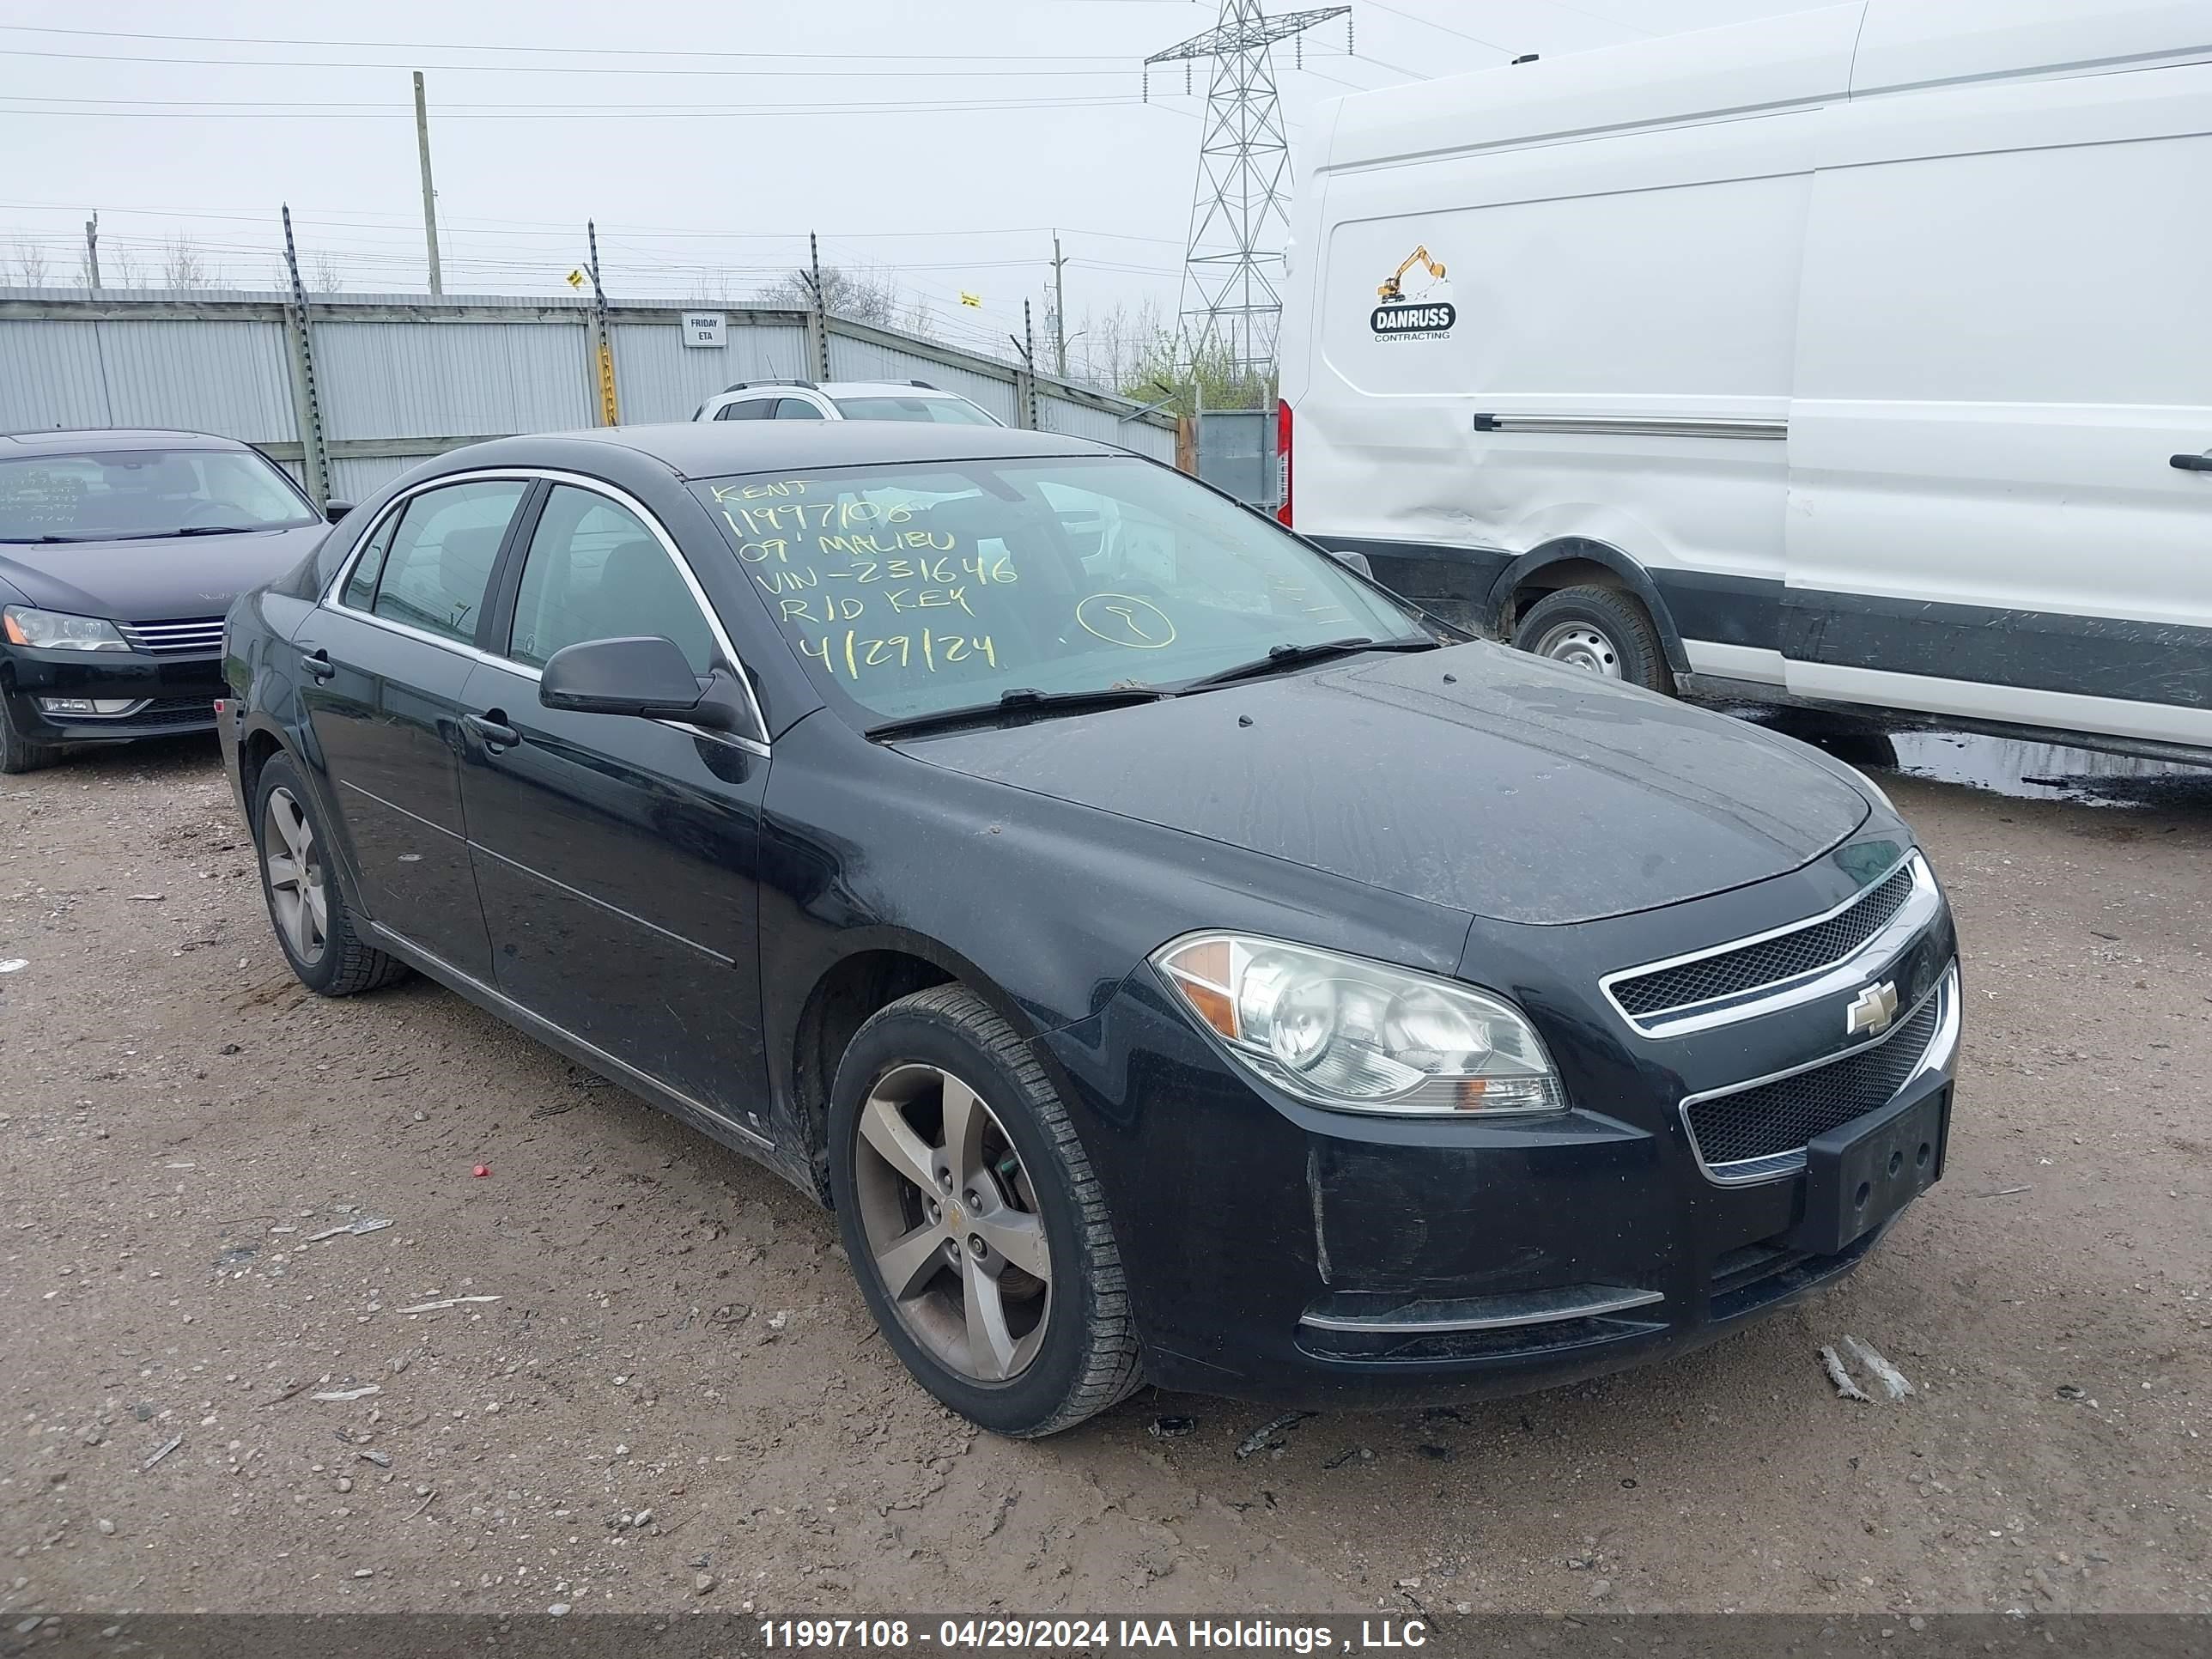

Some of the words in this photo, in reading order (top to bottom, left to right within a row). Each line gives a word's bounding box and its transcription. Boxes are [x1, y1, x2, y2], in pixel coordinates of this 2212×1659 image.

[690, 319, 718, 328] FRIDAY
[1376, 307, 1449, 329] DANRUSS
[698, 331, 714, 340] ETA
[1374, 331, 1450, 343] CONTRACTING
[710, 480, 820, 503] KENT
[721, 501, 912, 537] 11997106
[818, 532, 956, 556] MALIBU
[884, 586, 976, 618] KEY
[799, 628, 996, 680] 4/29/24
